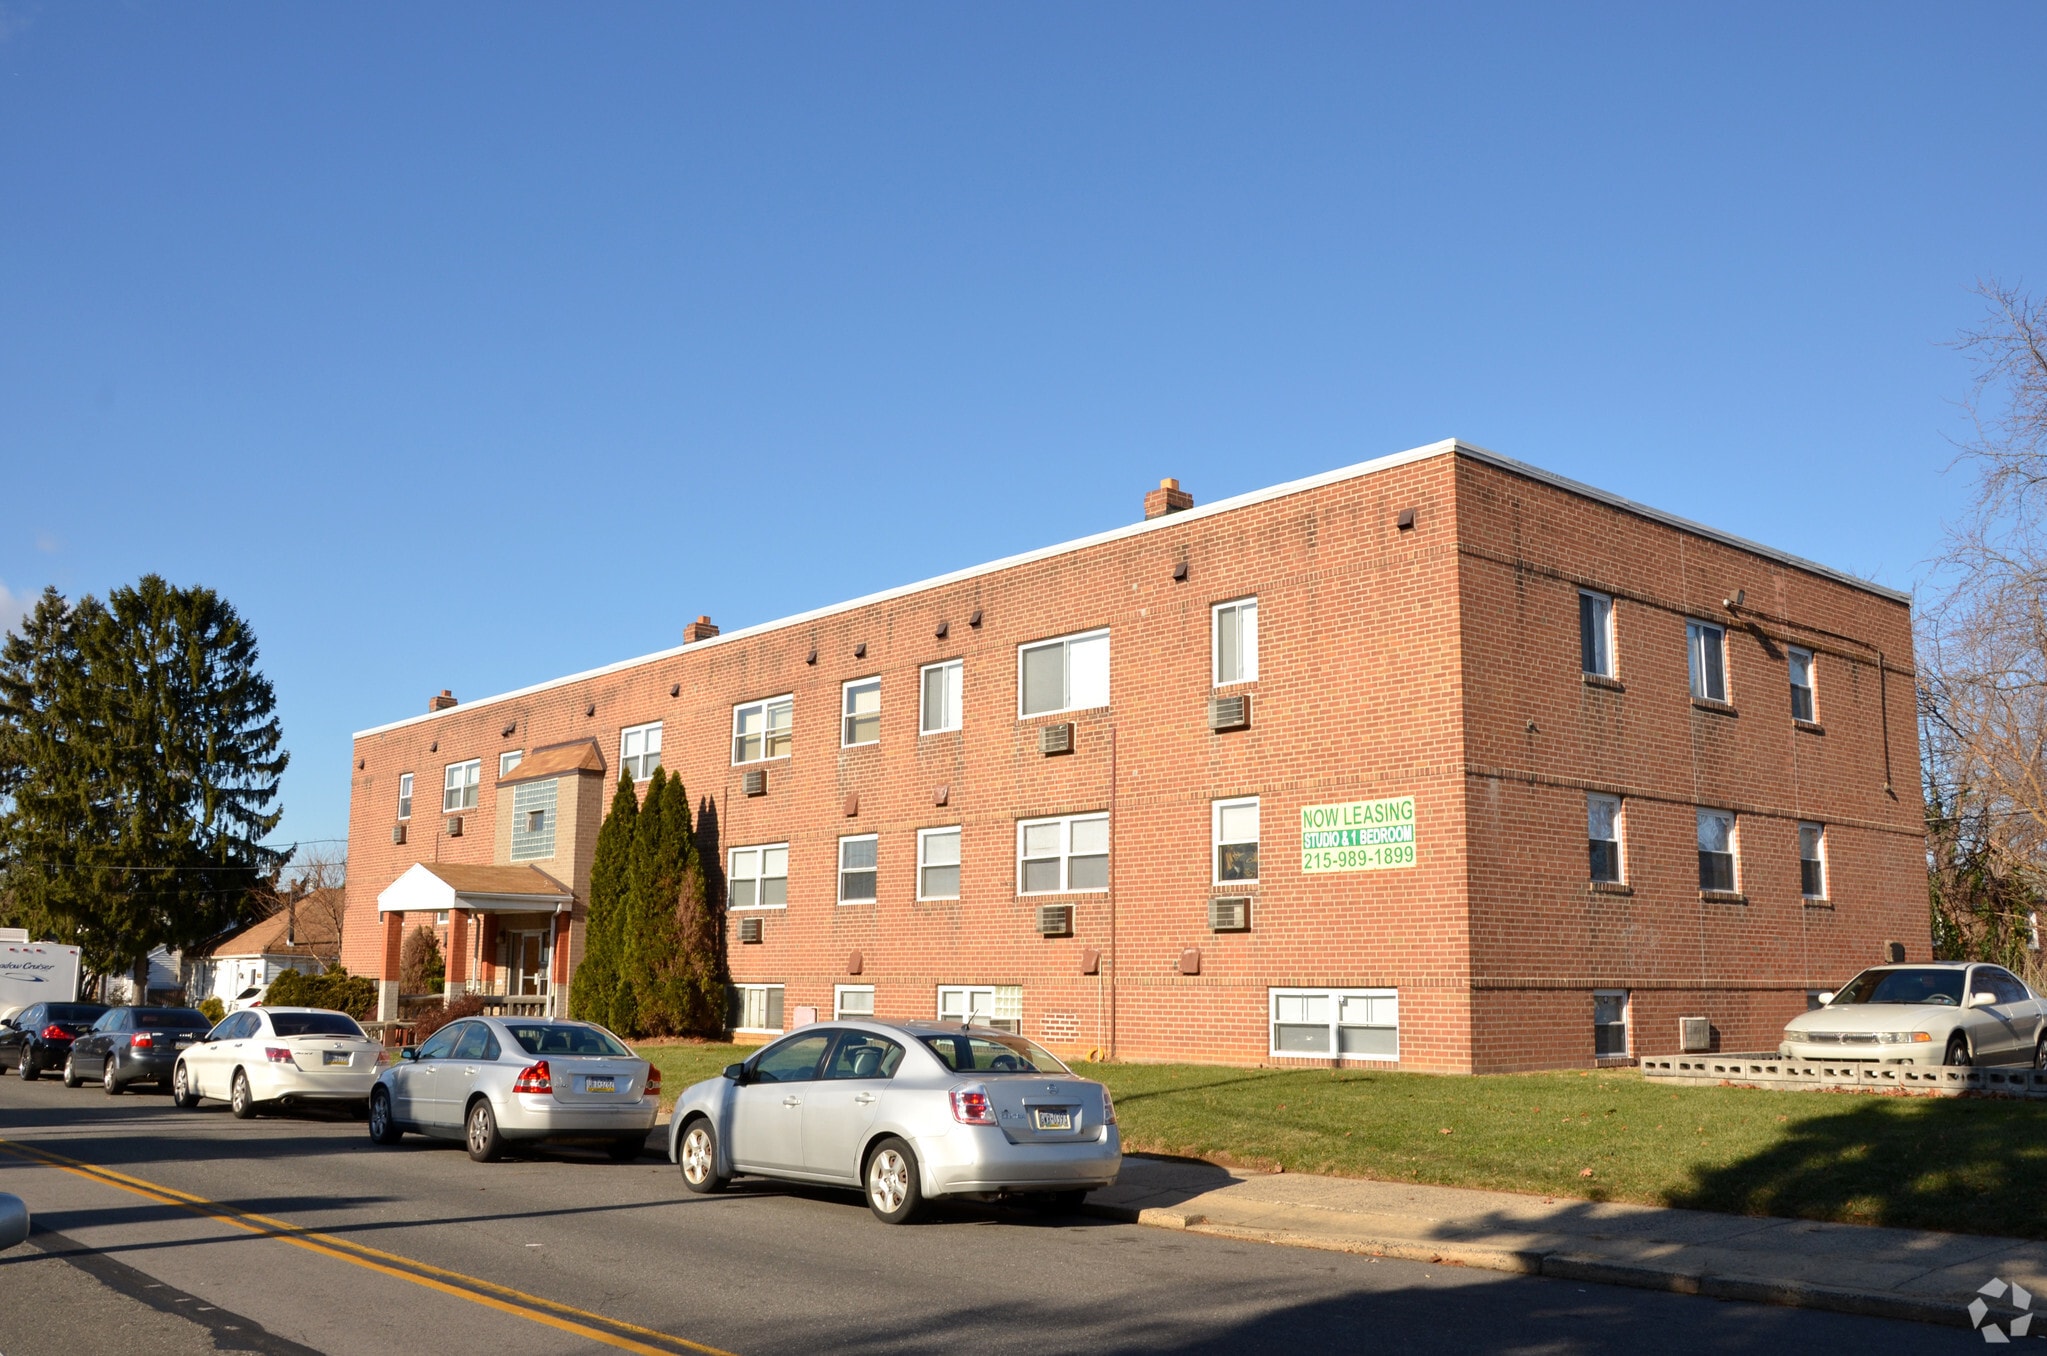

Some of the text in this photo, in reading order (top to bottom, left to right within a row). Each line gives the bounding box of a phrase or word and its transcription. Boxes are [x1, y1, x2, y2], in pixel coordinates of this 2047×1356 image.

[1303, 800, 1413, 828] NOW LEASING
[1304, 825, 1413, 848] STUDIO & 1 BEDROOM
[1304, 846, 1414, 869] 215-989-1899
[22, 962, 55, 970] Cruiser
